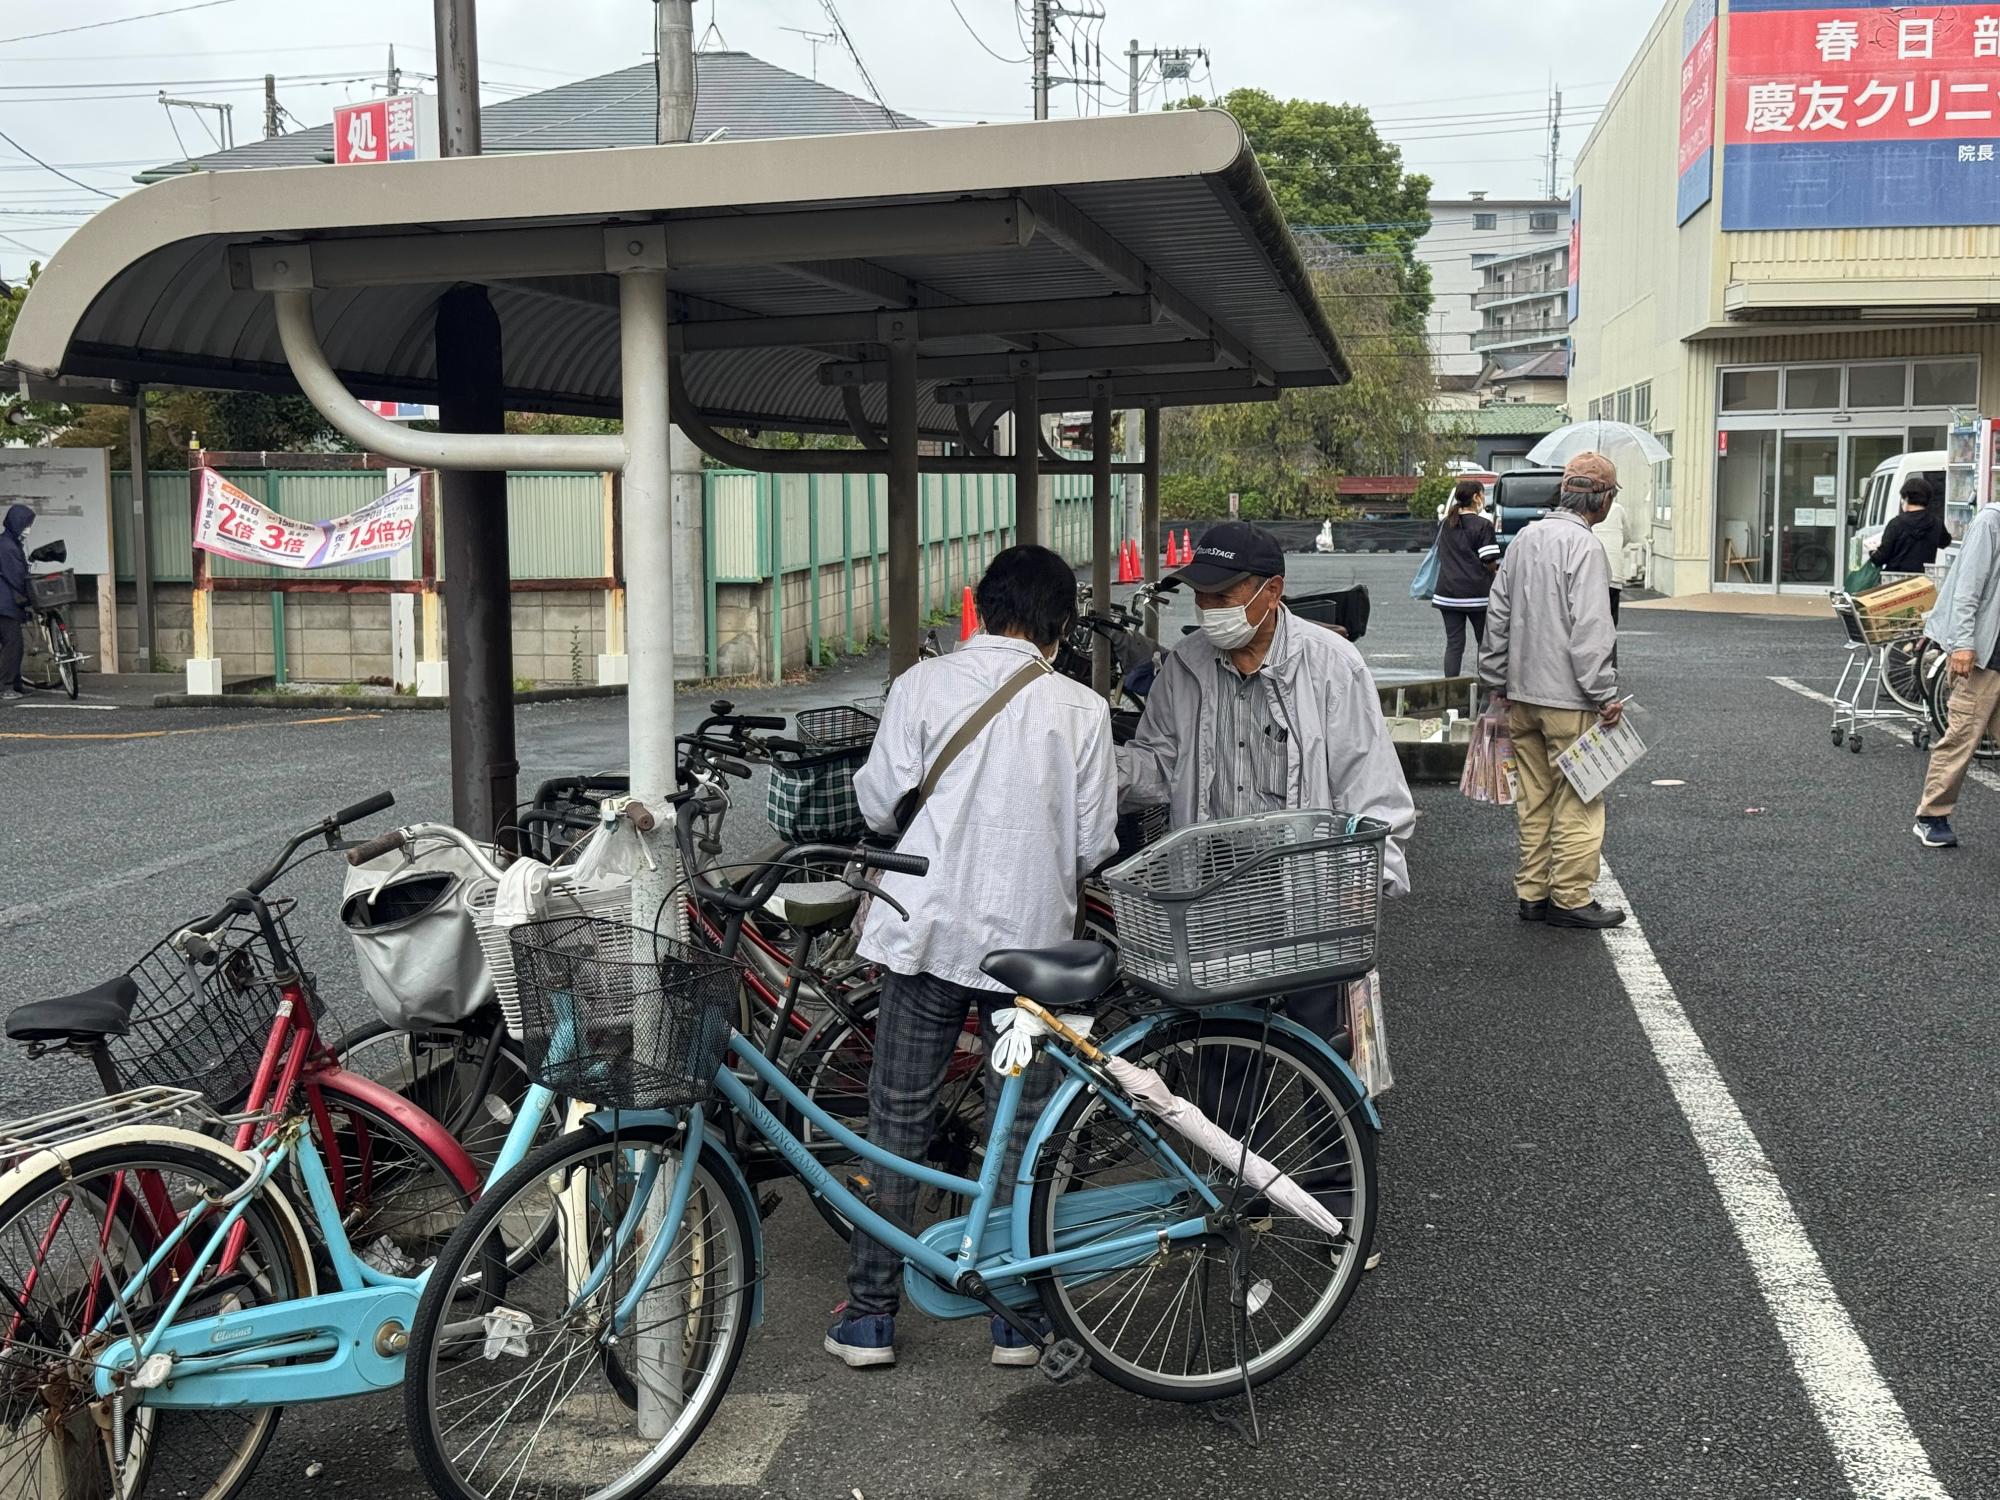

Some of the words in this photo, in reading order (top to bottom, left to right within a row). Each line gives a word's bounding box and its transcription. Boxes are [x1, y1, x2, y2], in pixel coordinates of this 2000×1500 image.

[388, 101, 414, 150] 薬
[1745, 80, 2000, 133] 慶友クリニ
[347, 111, 377, 162] 処
[1958, 145, 1994, 162] 院長
